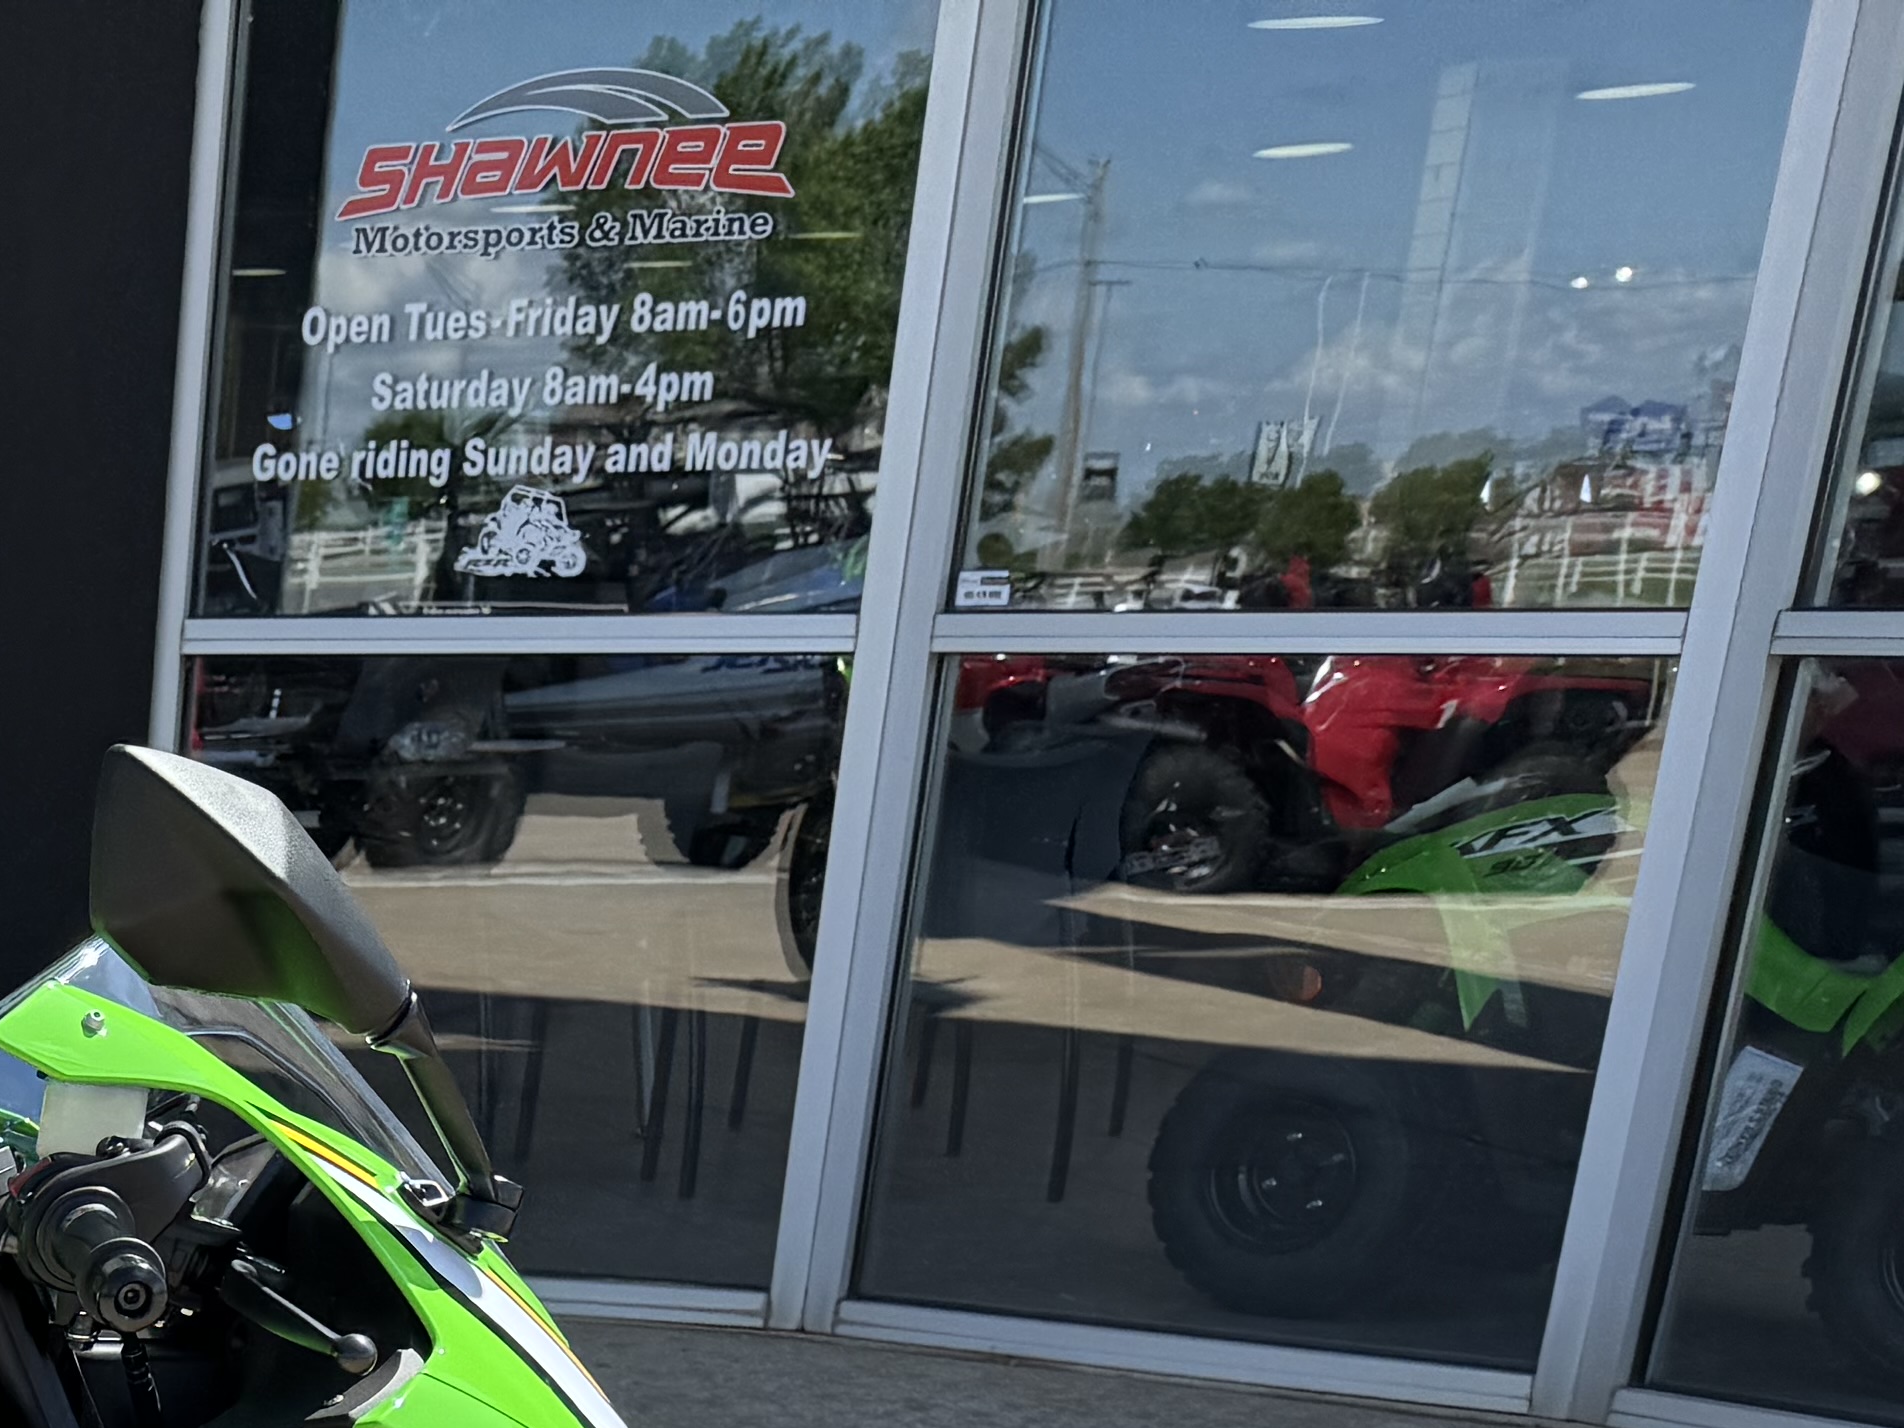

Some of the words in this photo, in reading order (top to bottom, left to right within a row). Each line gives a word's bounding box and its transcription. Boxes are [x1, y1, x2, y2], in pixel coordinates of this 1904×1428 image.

[352, 219, 578, 260] Motorsports
[586, 212, 619, 246] &
[625, 208, 774, 243] Marine
[301, 307, 390, 353] Open
[405, 297, 619, 345] Tues-Friday
[631, 291, 807, 338] 8am-6pm
[371, 368, 531, 415] Saturday
[543, 362, 715, 412] 8am-4pm
[252, 442, 340, 482] Gone
[351, 440, 452, 487] riding
[462, 436, 595, 482] Sunday
[605, 432, 673, 474] and
[685, 429, 833, 475] Monday
